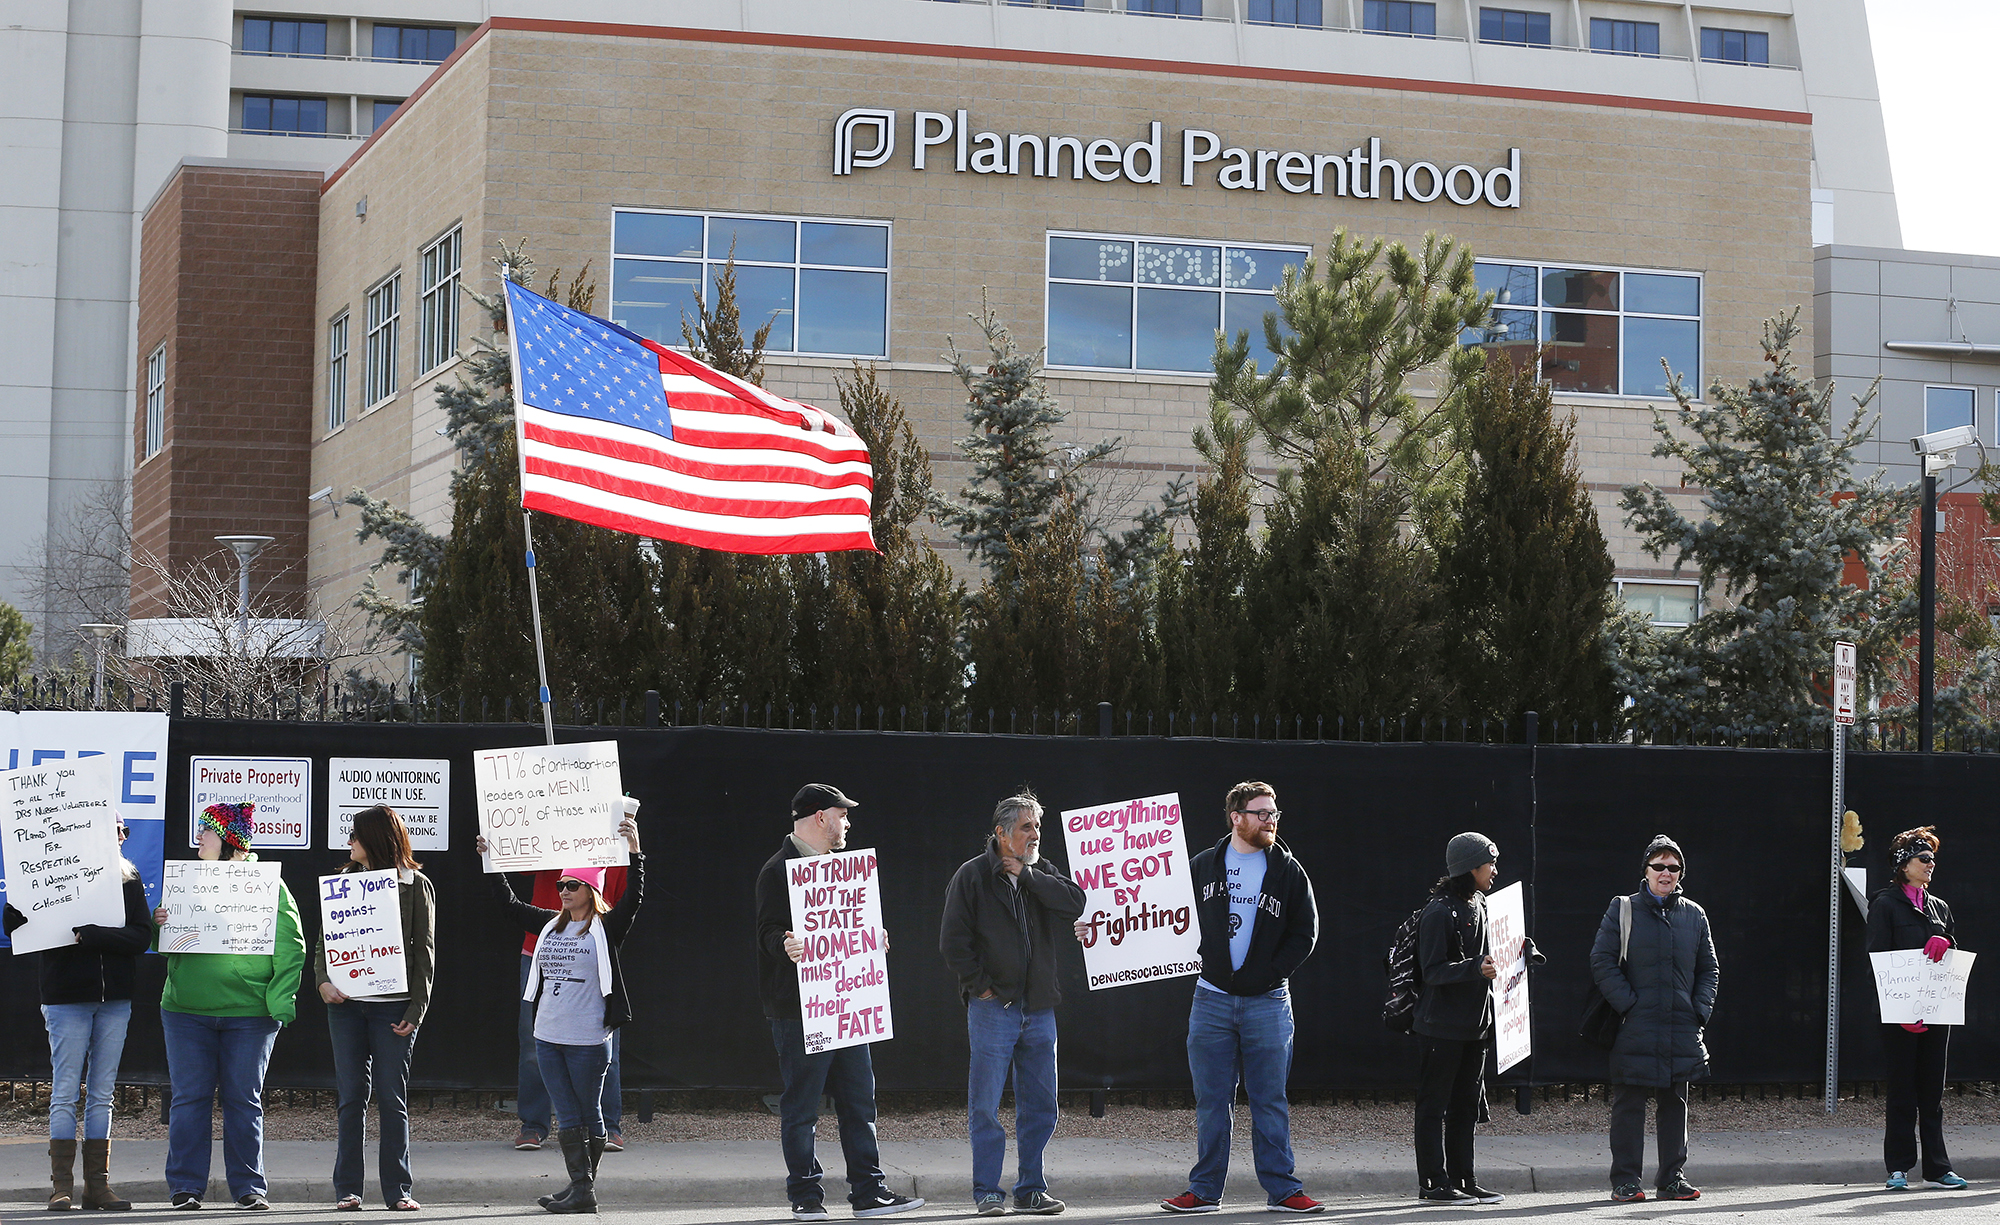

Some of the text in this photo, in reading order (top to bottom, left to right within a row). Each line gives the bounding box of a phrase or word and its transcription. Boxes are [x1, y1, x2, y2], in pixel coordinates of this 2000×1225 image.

[913, 109, 1520, 208] Planned Parenthood
[1099, 243, 1257, 288] PROUD
[483, 751, 618, 781] 77% of anti-abortion
[9, 773, 47, 791] THANK
[200, 767, 301, 787] Private Property
[339, 770, 441, 784] AUDIO MONITORING
[29, 795, 42, 803] ALL
[48, 791, 66, 800] THE
[209, 793, 301, 803] Planned Parenthood
[352, 786, 426, 801] DEVICE IN USE.
[483, 776, 590, 803] leaders are MEN!!
[15, 809, 32, 820] DRS
[260, 805, 280, 814] Only
[408, 814, 425, 823] MAY
[429, 815, 438, 823] BE
[487, 803, 609, 829] 100% of those will
[1068, 800, 1179, 833] everything
[44, 842, 62, 855] FOR
[488, 834, 619, 858] NEVER be pregnant
[1080, 829, 1173, 856] we have
[19, 855, 81, 875] RESPECTING
[165, 863, 261, 879] If the fetus
[792, 855, 877, 887] NOT TRUMP
[1075, 851, 1173, 891] WE GOT
[1227, 868, 1240, 876] nd
[31, 879, 39, 889] A
[55, 884, 66, 892] TO
[165, 884, 185, 899] you
[193, 883, 219, 894] save
[229, 881, 238, 893] is
[244, 880, 273, 896] GAY,
[323, 877, 351, 901] If
[804, 886, 866, 909] NOT THE
[1113, 884, 1141, 906] BY
[164, 902, 274, 918] Will you continue to
[330, 904, 376, 924] against
[804, 908, 864, 931] STATE
[163, 922, 199, 934] Protect
[203, 921, 218, 932] its
[1083, 902, 1190, 948] fighting
[1491, 915, 1510, 947] FREE
[327, 943, 402, 965] Don't have
[801, 926, 877, 963] WOMEN
[349, 965, 375, 979] one
[801, 956, 842, 983] must
[835, 959, 884, 993] decide
[1877, 970, 1920, 987] Planned
[1884, 988, 1911, 1000] Keep
[1917, 984, 1936, 999] the
[805, 994, 850, 1019] their
[838, 1005, 884, 1039] FATE
